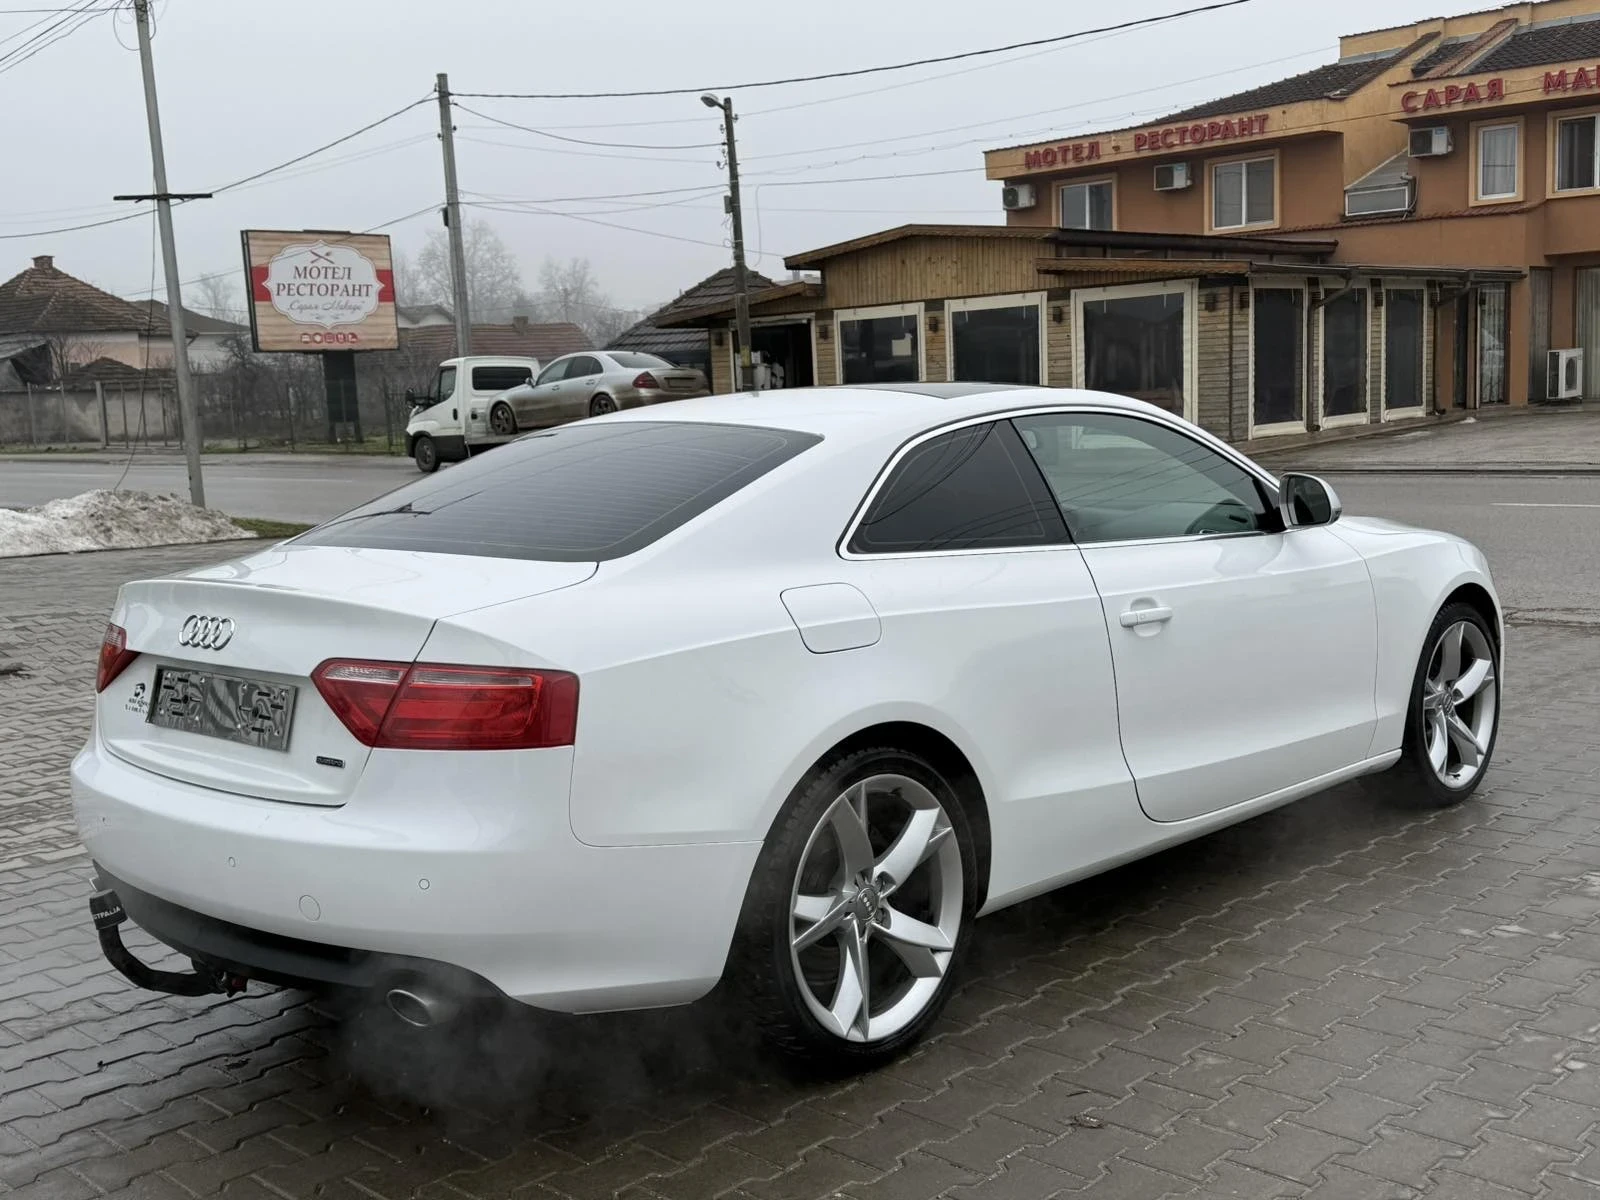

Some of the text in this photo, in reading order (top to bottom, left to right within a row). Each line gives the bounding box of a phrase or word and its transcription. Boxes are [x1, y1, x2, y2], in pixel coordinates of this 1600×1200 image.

[1401, 65, 1600, 113] САРАЯ МА
[1024, 114, 1269, 169] МОТЕЛ РЕСТОРАНТ
[293, 265, 352, 280] МОТЕЛ
[276, 283, 373, 297] РЕСТОРАНТ
